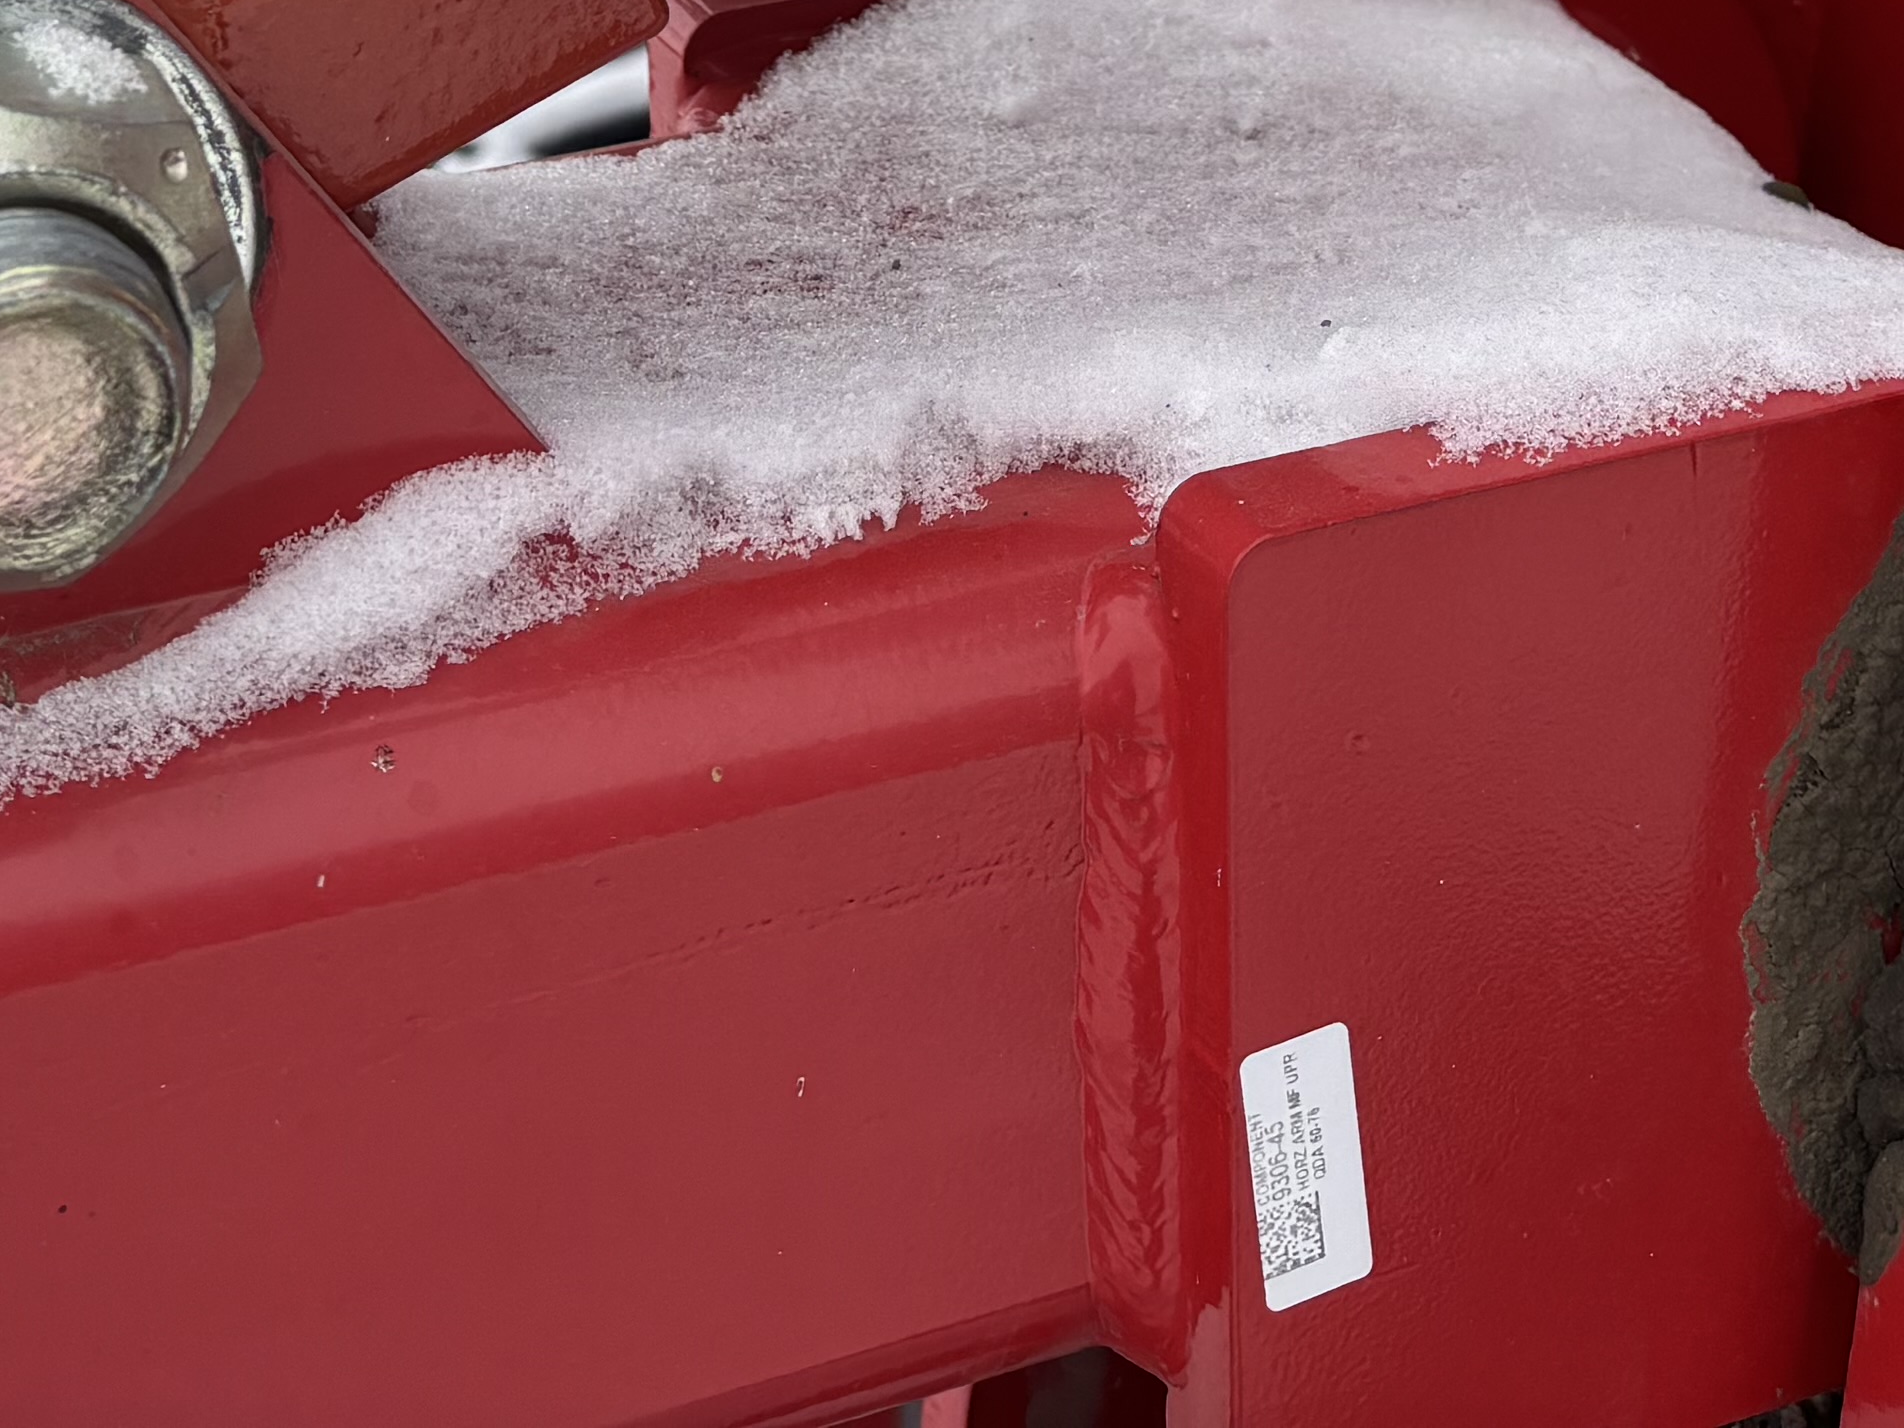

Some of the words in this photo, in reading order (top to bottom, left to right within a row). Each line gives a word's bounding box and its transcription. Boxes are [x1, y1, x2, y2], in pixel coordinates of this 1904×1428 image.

[1283, 1052, 1299, 1085] UPR
[1290, 1110, 1305, 1144] ARM
[1248, 1113, 1270, 1206] COMPONENT
[1264, 1121, 1292, 1201] 9306-45
[1293, 1146, 1310, 1191] HORZ
